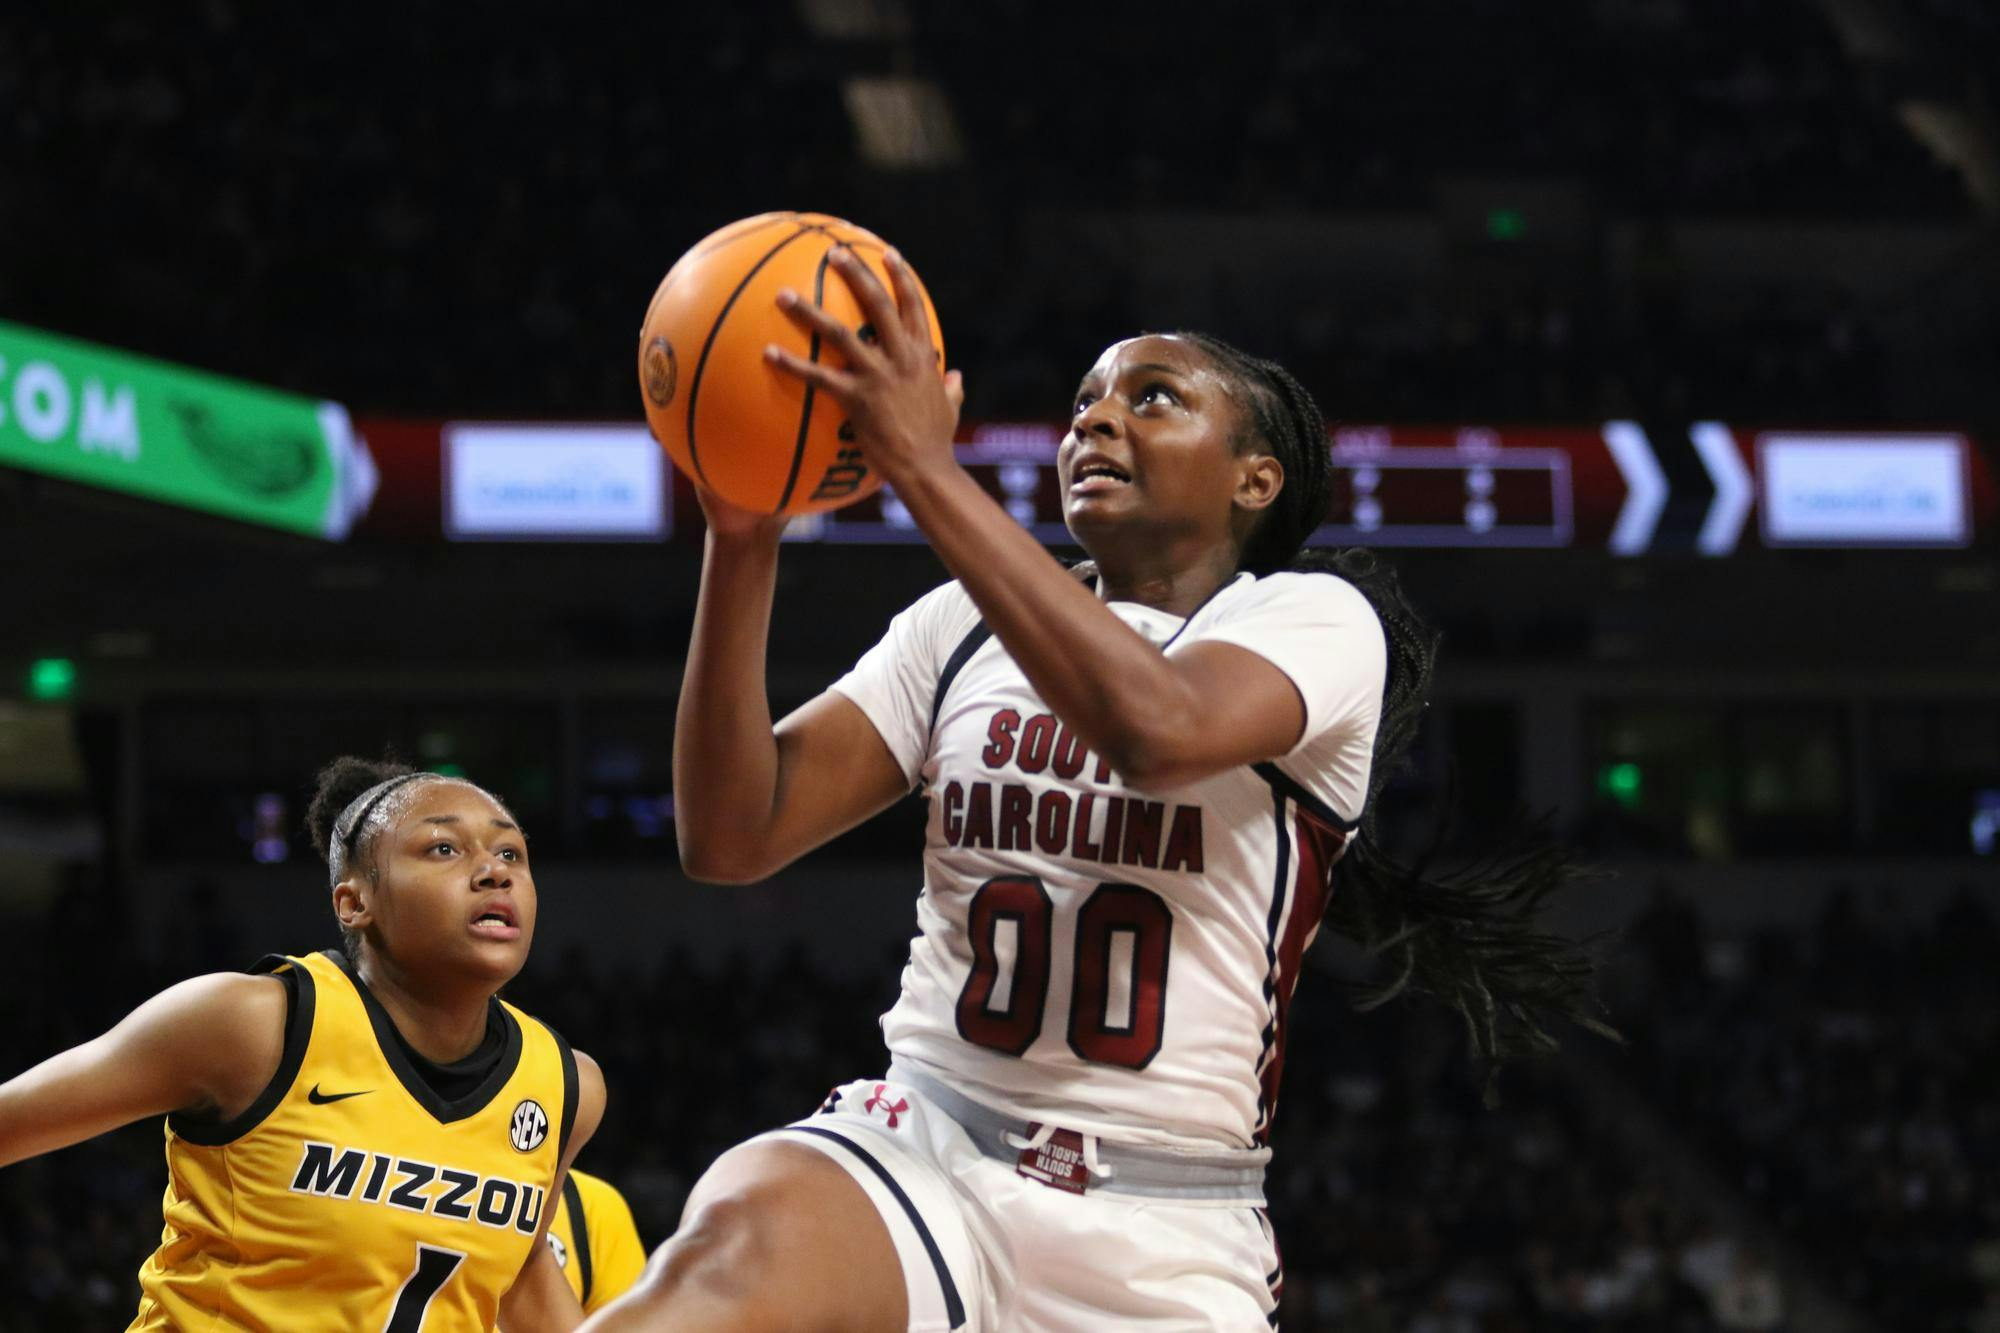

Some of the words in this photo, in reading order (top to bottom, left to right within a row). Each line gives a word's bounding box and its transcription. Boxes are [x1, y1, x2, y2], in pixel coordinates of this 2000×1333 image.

[0, 352, 140, 463] OM
[982, 708, 1112, 785] SOU
[942, 780, 1204, 874] CAROLINA
[955, 875, 1173, 1072] 00
[511, 1101, 548, 1152] SEC
[1035, 1155, 1074, 1177] SOUTH
[289, 1140, 543, 1236] MIZZOU
